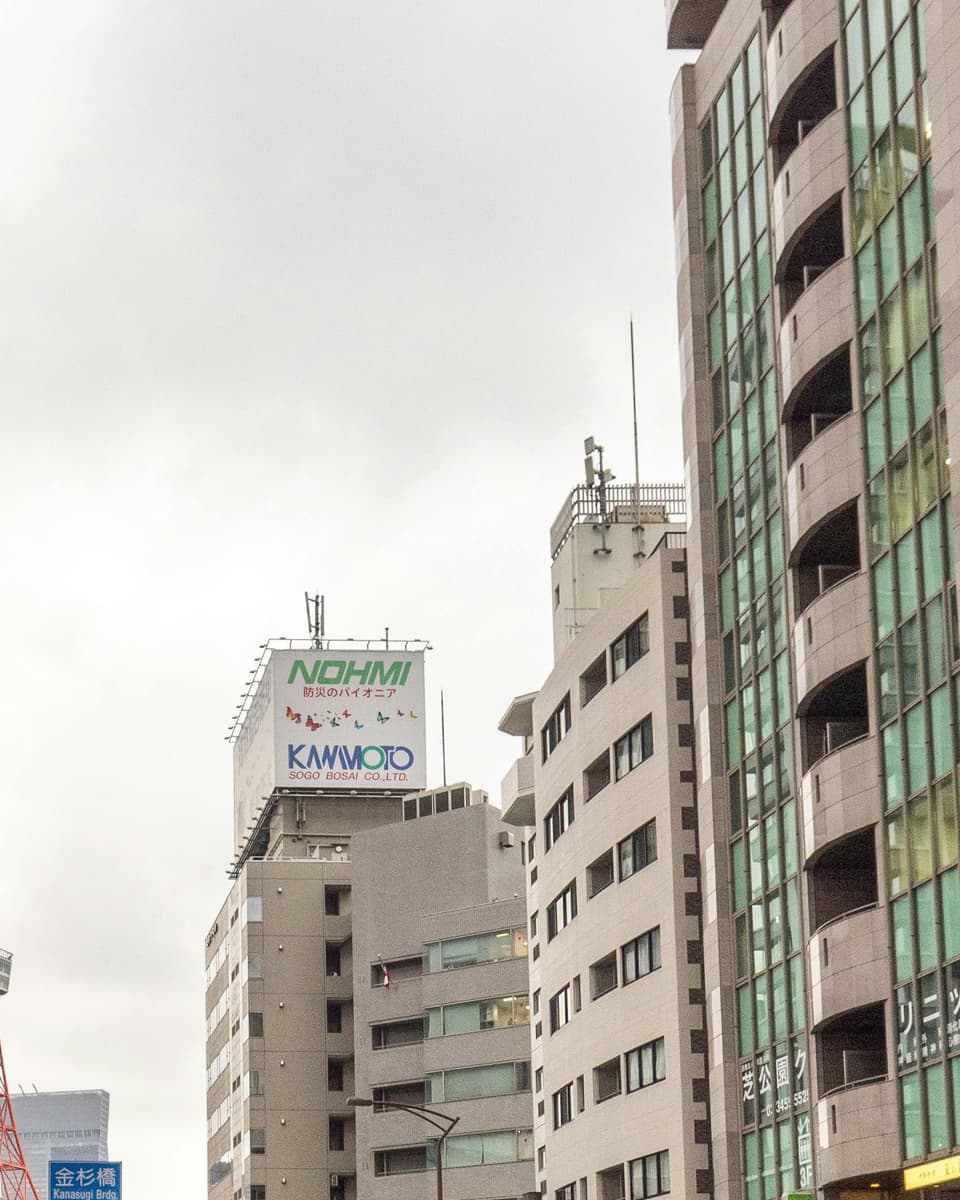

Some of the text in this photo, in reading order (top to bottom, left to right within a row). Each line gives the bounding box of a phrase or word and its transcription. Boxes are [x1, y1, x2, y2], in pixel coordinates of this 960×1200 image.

[287, 659, 412, 686] NOHMI
[303, 687, 397, 698] 防災のパイオニア
[289, 771, 320, 780] SOGO
[326, 771, 359, 781] BOSAI
[55, 1167, 116, 1187] 金杉橋
[53, 1189, 93, 1200] Kanasugi
